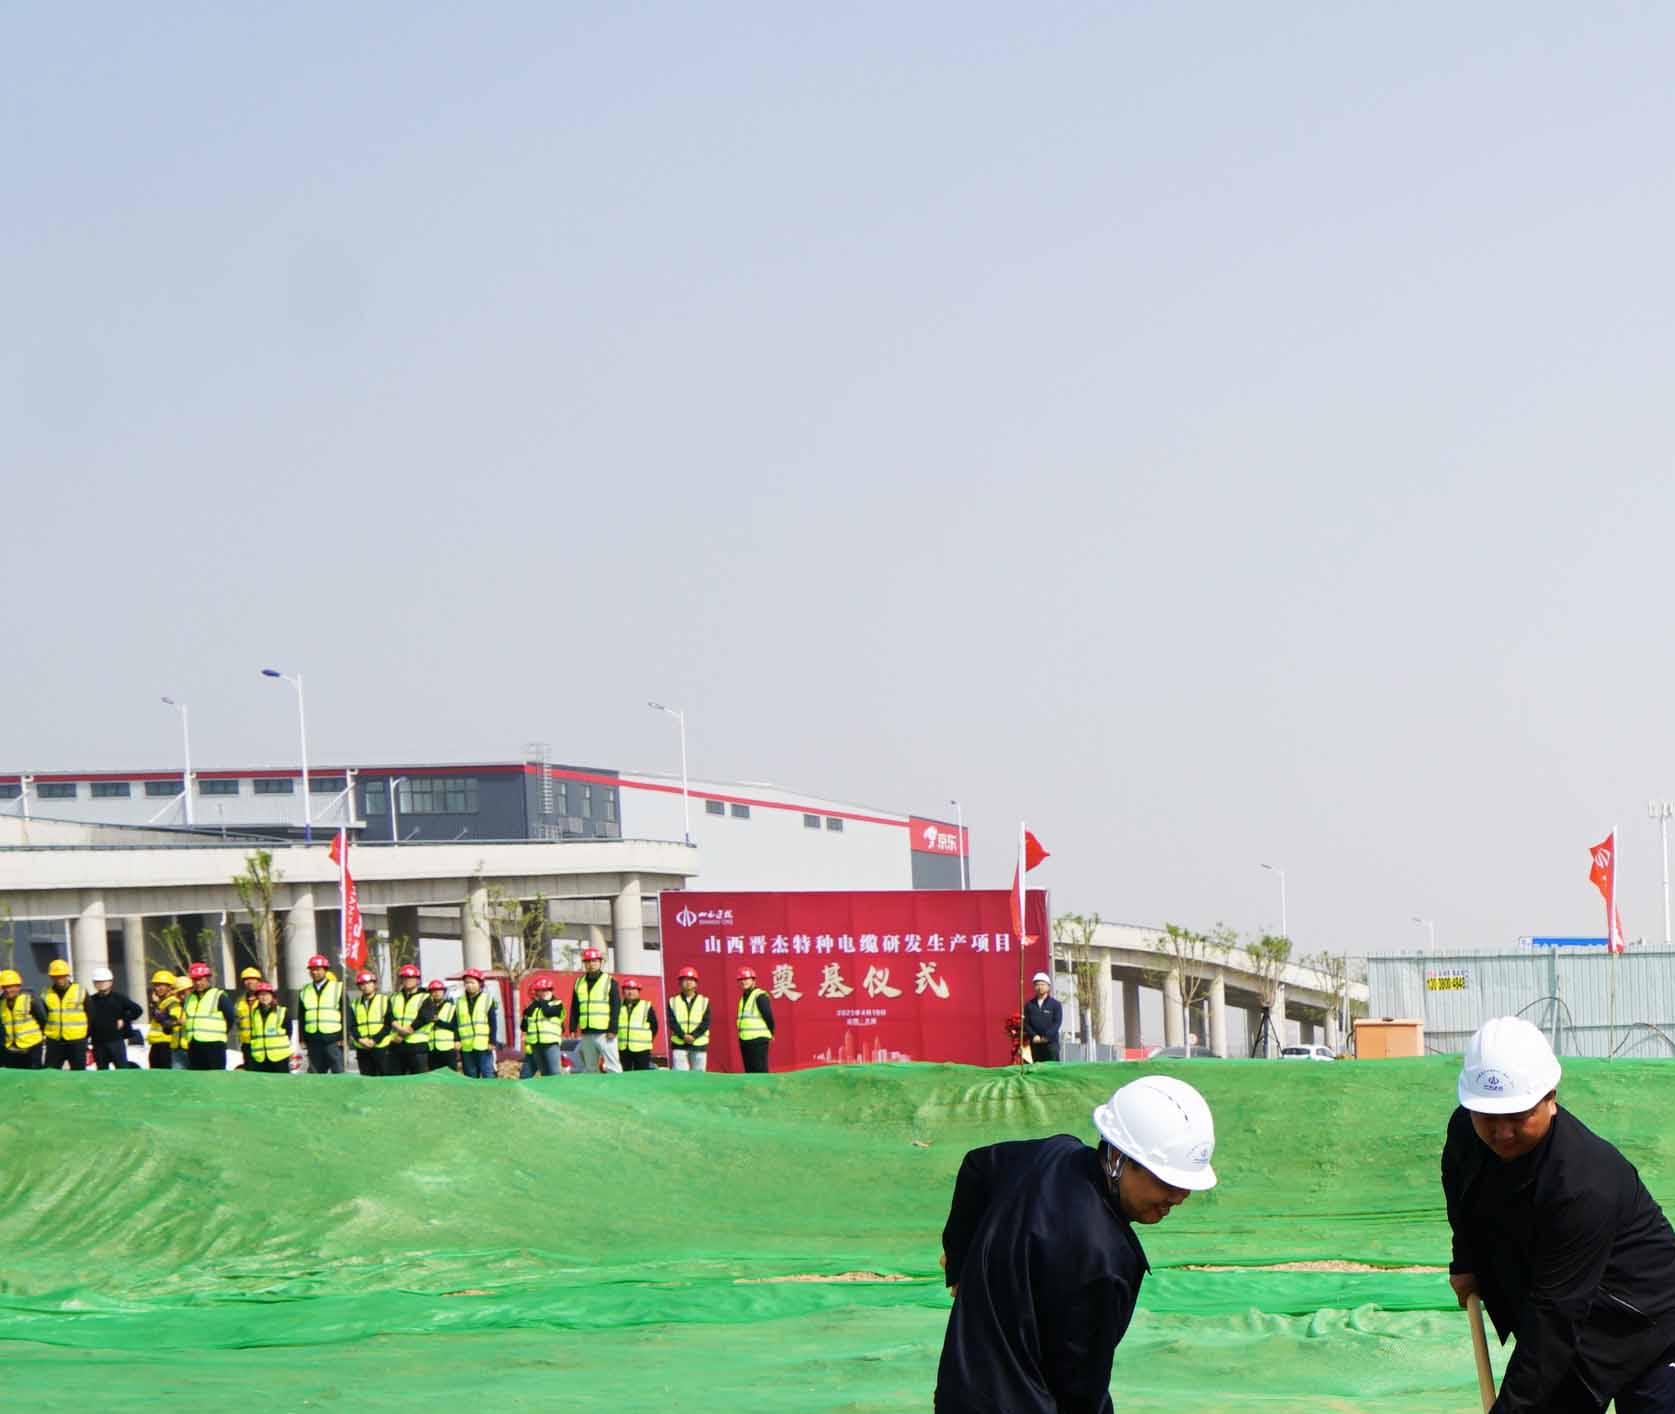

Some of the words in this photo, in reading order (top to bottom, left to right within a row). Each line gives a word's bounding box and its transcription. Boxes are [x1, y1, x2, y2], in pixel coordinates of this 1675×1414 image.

[704, 934, 1012, 955] 山西晋杰特种电缆研发生产项目
[770, 962, 950, 1001] 奠基仪式
